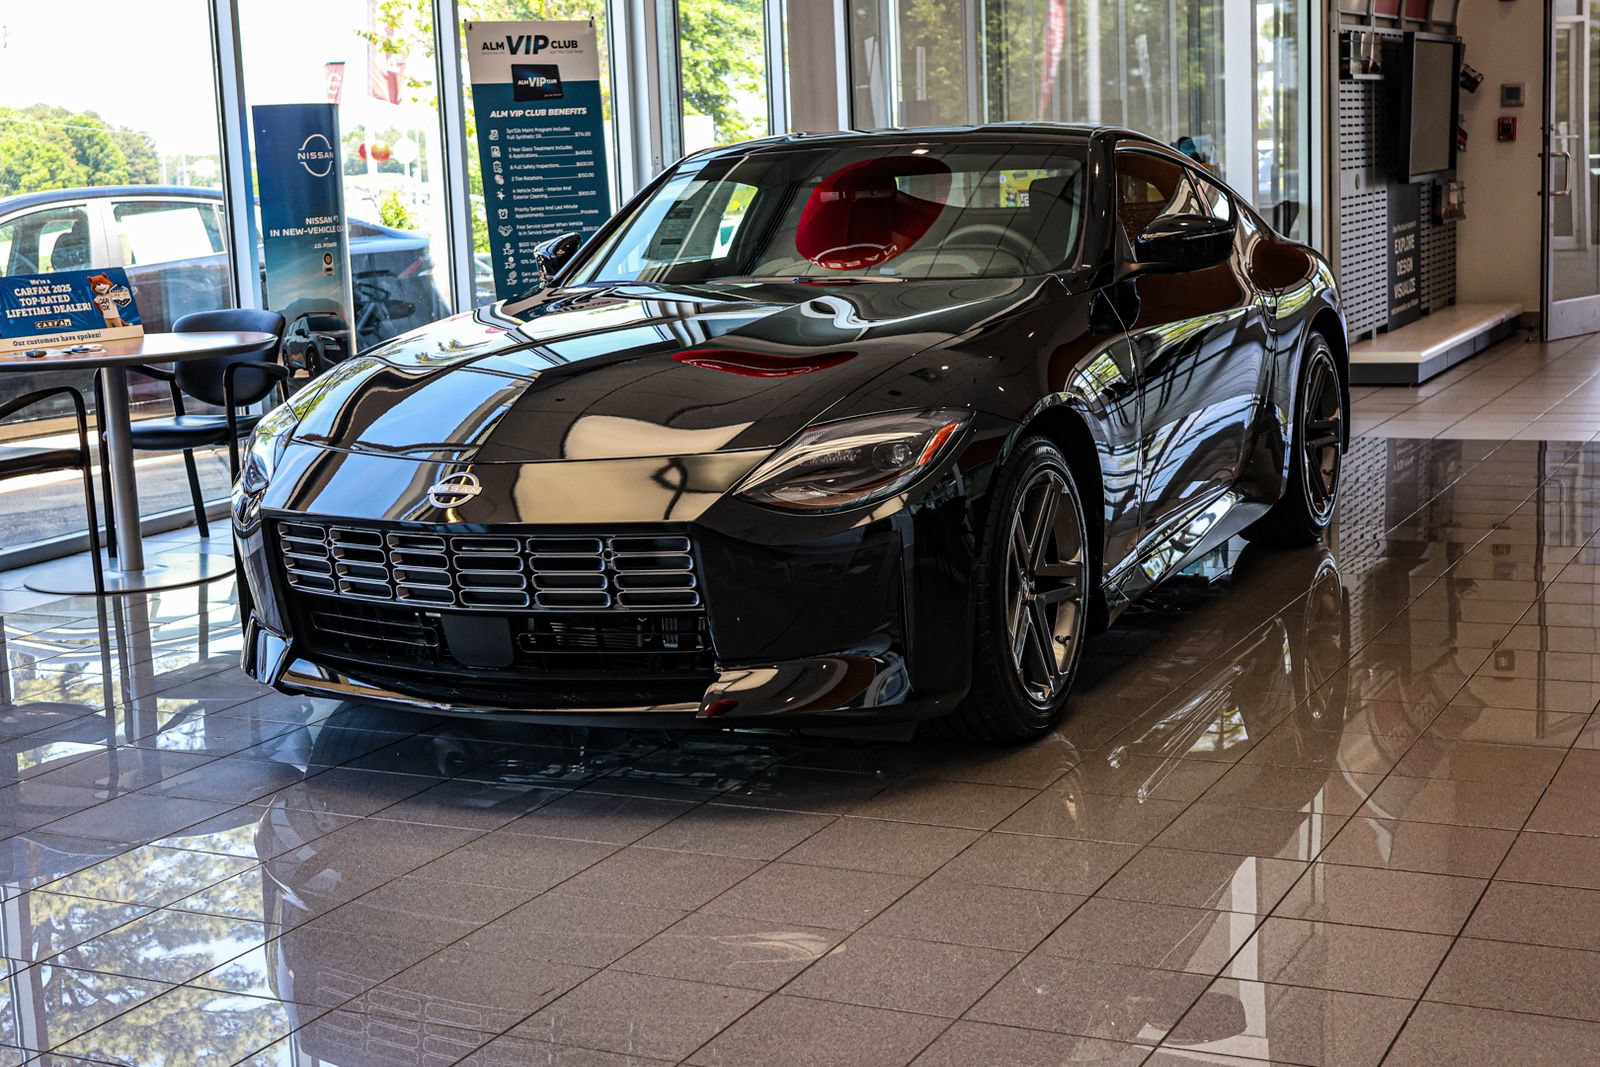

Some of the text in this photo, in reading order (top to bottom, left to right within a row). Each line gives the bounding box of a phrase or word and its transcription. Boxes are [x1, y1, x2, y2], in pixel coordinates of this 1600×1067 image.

[482, 42, 504, 50] ALM
[506, 35, 550, 55] VIP
[550, 40, 578, 49] CLUB
[529, 77, 547, 87] VIP
[490, 110, 509, 118] ALM
[525, 108, 546, 116] CLUB
[548, 107, 587, 116] BENEFITS
[297, 151, 334, 160] NISSAN
[306, 216, 332, 225] NISSAN
[270, 229, 280, 237] IN
[282, 225, 336, 236] NEW-VEHICLE
[1394, 234, 1415, 254] EXPLORE
[1397, 256, 1413, 276] DESIGN
[14, 284, 72, 296] CARFAX 2025
[1394, 277, 1416, 299] VISUALIZE
[20, 294, 70, 307] TOP-RATED
[5, 302, 92, 318] LIFETIME DEALER!
[36, 319, 72, 329] CARFAX
[26, 338, 60, 346] customers
[77, 332, 101, 341] spoken!
[430, 486, 478, 494] NISSAN
